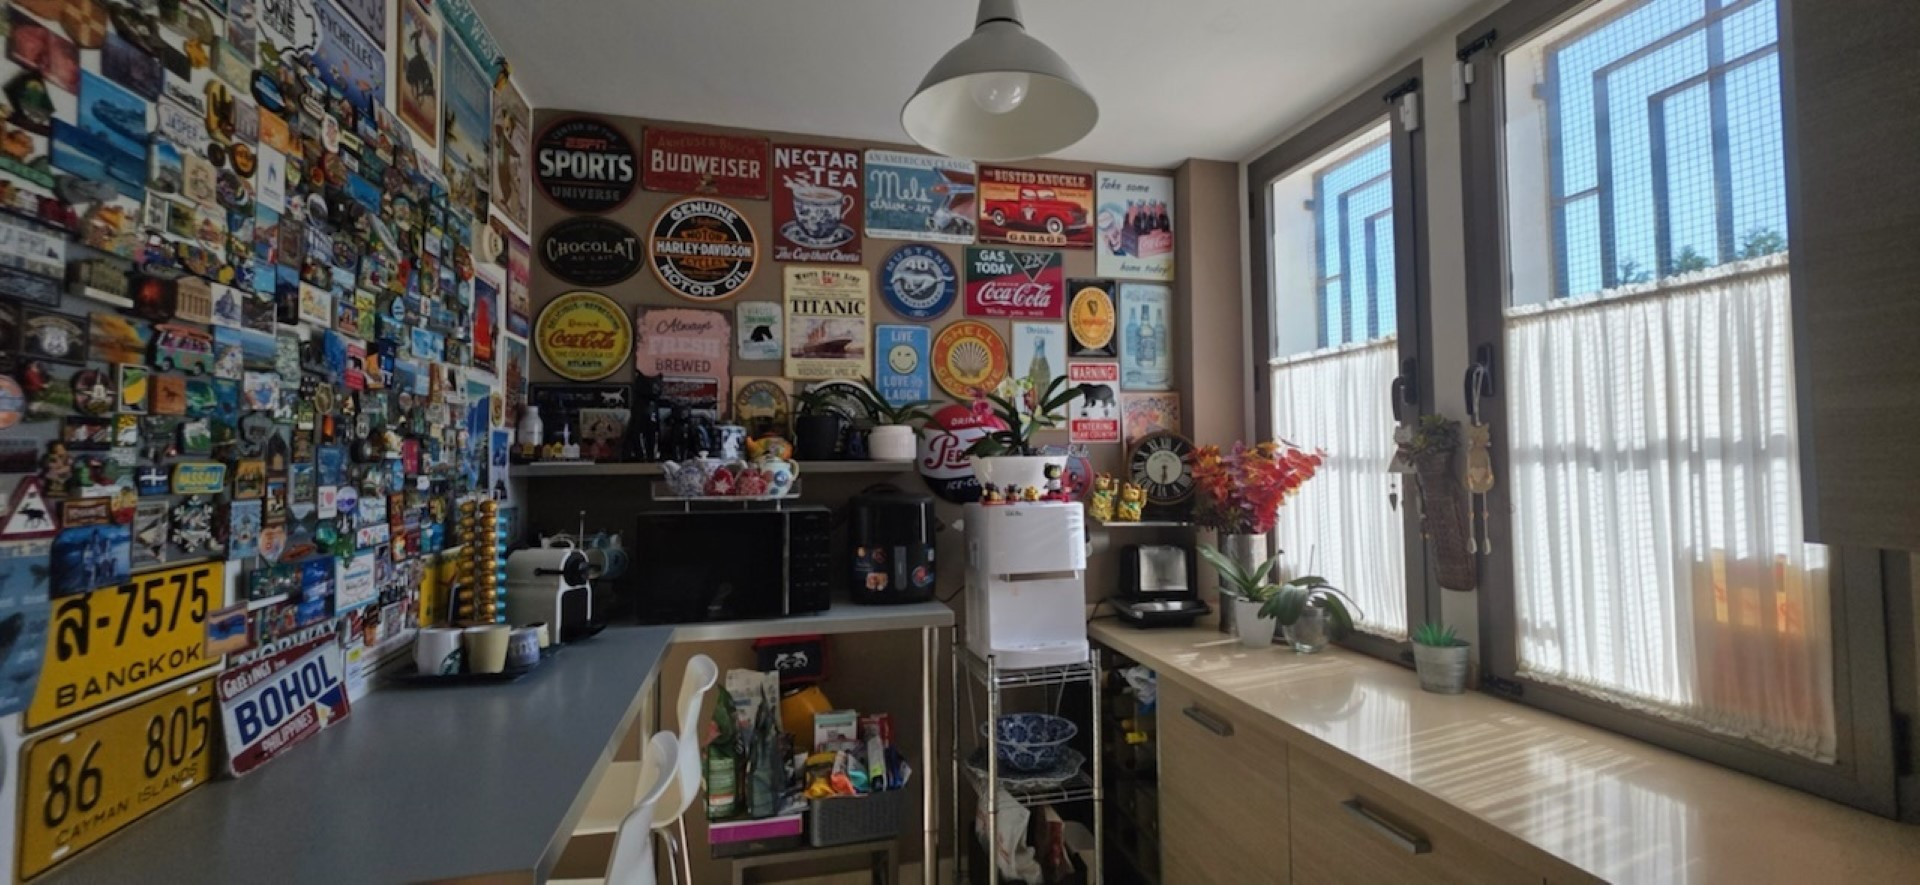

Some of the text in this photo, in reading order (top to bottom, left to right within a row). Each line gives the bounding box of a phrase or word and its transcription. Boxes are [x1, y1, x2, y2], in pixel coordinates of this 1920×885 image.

[540, 148, 633, 182] SPORTS
[651, 148, 761, 179] BUDWEISER
[775, 147, 858, 169] NECTAR
[809, 166, 858, 188] TEA
[994, 169, 1036, 183] BUSTED
[1037, 172, 1087, 188] KNUCKLE
[1100, 177, 1150, 192] Take some
[551, 186, 620, 201] UNIVERSE
[670, 202, 738, 223] GENUINE
[1009, 233, 1065, 244] GARAGE
[547, 237, 635, 262] CHOCOLAT
[656, 240, 752, 257] HARLEY-DAVIDSON
[979, 250, 1006, 263] GAS
[886, 248, 950, 274] MUSTANG
[975, 262, 1014, 275] TODAY
[660, 265, 749, 296] MOTOR OIL
[977, 281, 1054, 308] Coca-Cola
[790, 299, 866, 315] TITANIC
[656, 317, 713, 334] Always
[891, 330, 913, 342] LIVE
[943, 326, 993, 345] SHELL
[655, 359, 712, 373] BREWED
[883, 376, 908, 387] LOVE
[885, 389, 920, 400] LAUGH
[951, 416, 982, 426] DRINK
[55, 643, 202, 708] BANGKOK
[234, 655, 337, 746] BOHOL
[43, 695, 211, 828] 86 805
[54, 761, 199, 848] CAYMAN ISLANDS
